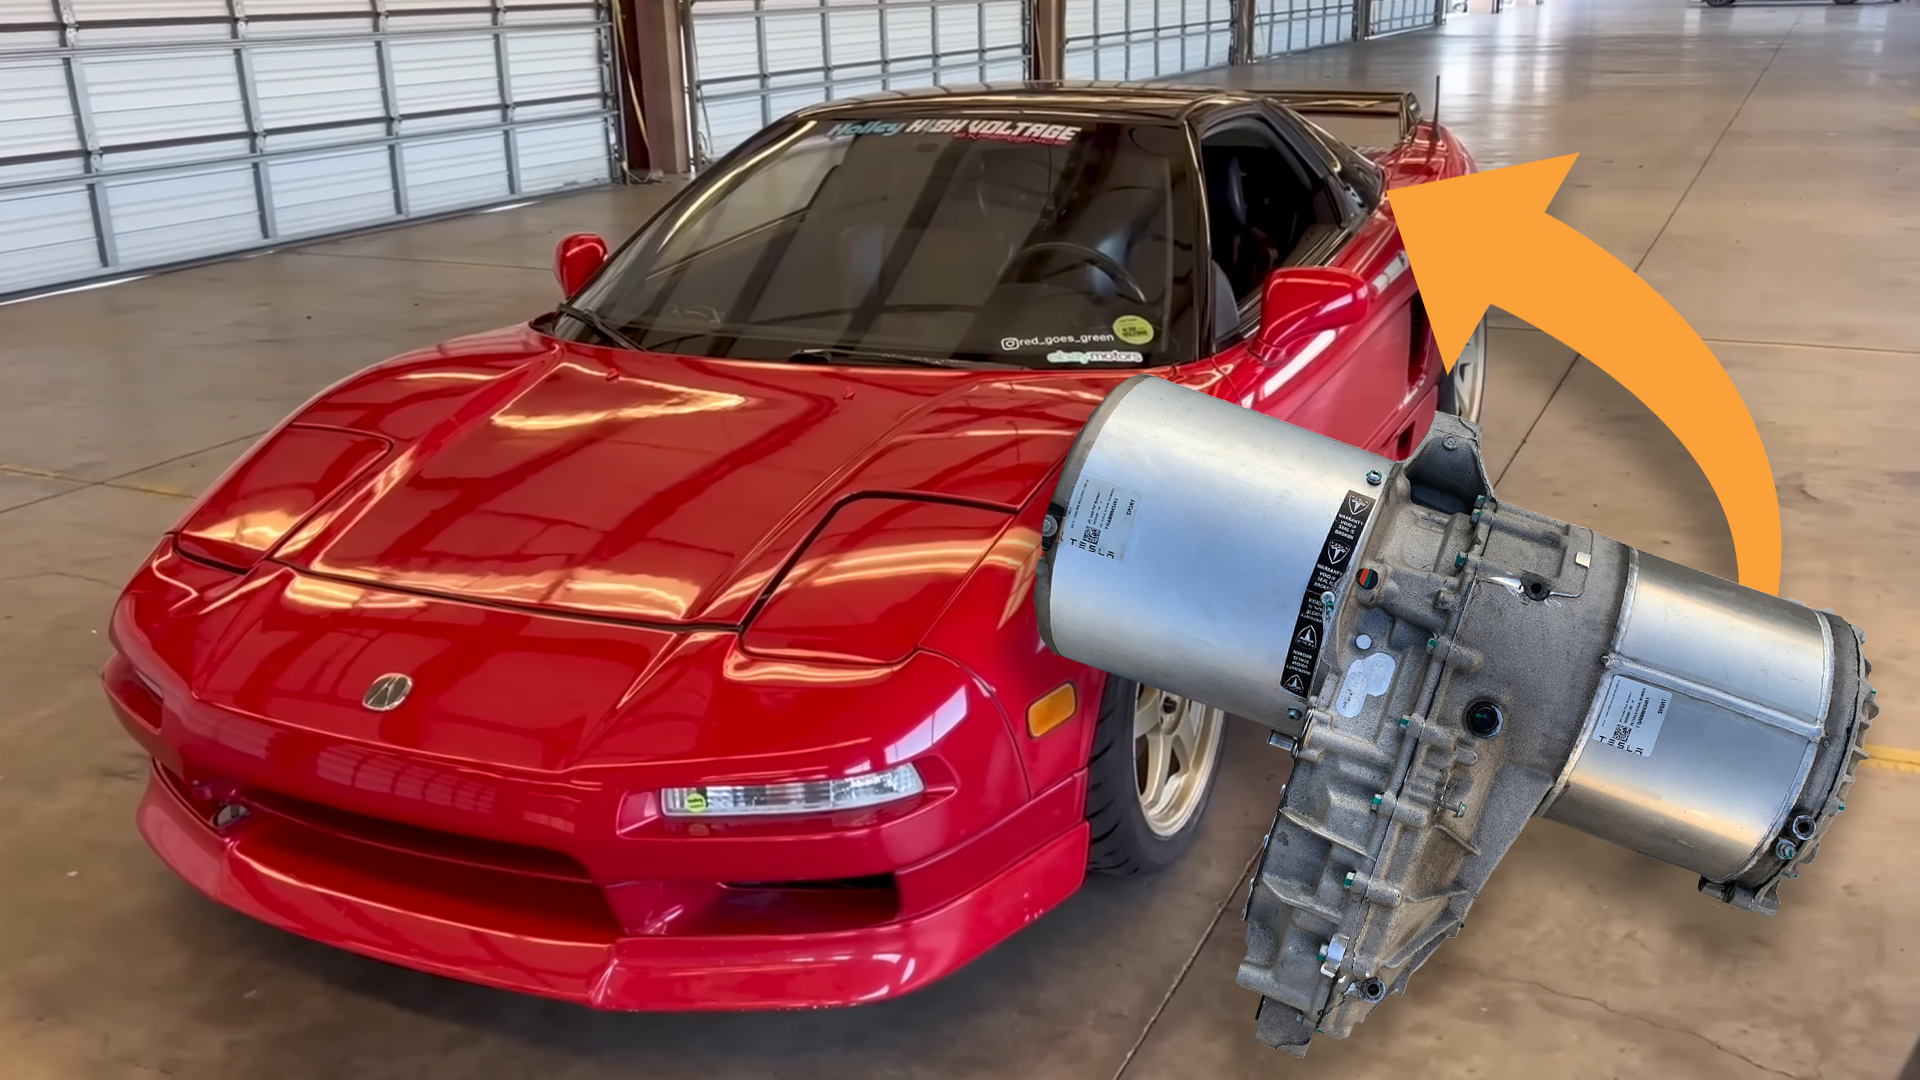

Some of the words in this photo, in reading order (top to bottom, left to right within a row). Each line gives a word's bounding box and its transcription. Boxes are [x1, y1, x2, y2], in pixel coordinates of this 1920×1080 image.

[827, 121, 907, 137] Holley
[968, 120, 1083, 141] VOLTAGE
[1020, 334, 1115, 346] red_goes_green
[1089, 350, 1143, 362] motors
[1338, 513, 1364, 526] WARRANTY
